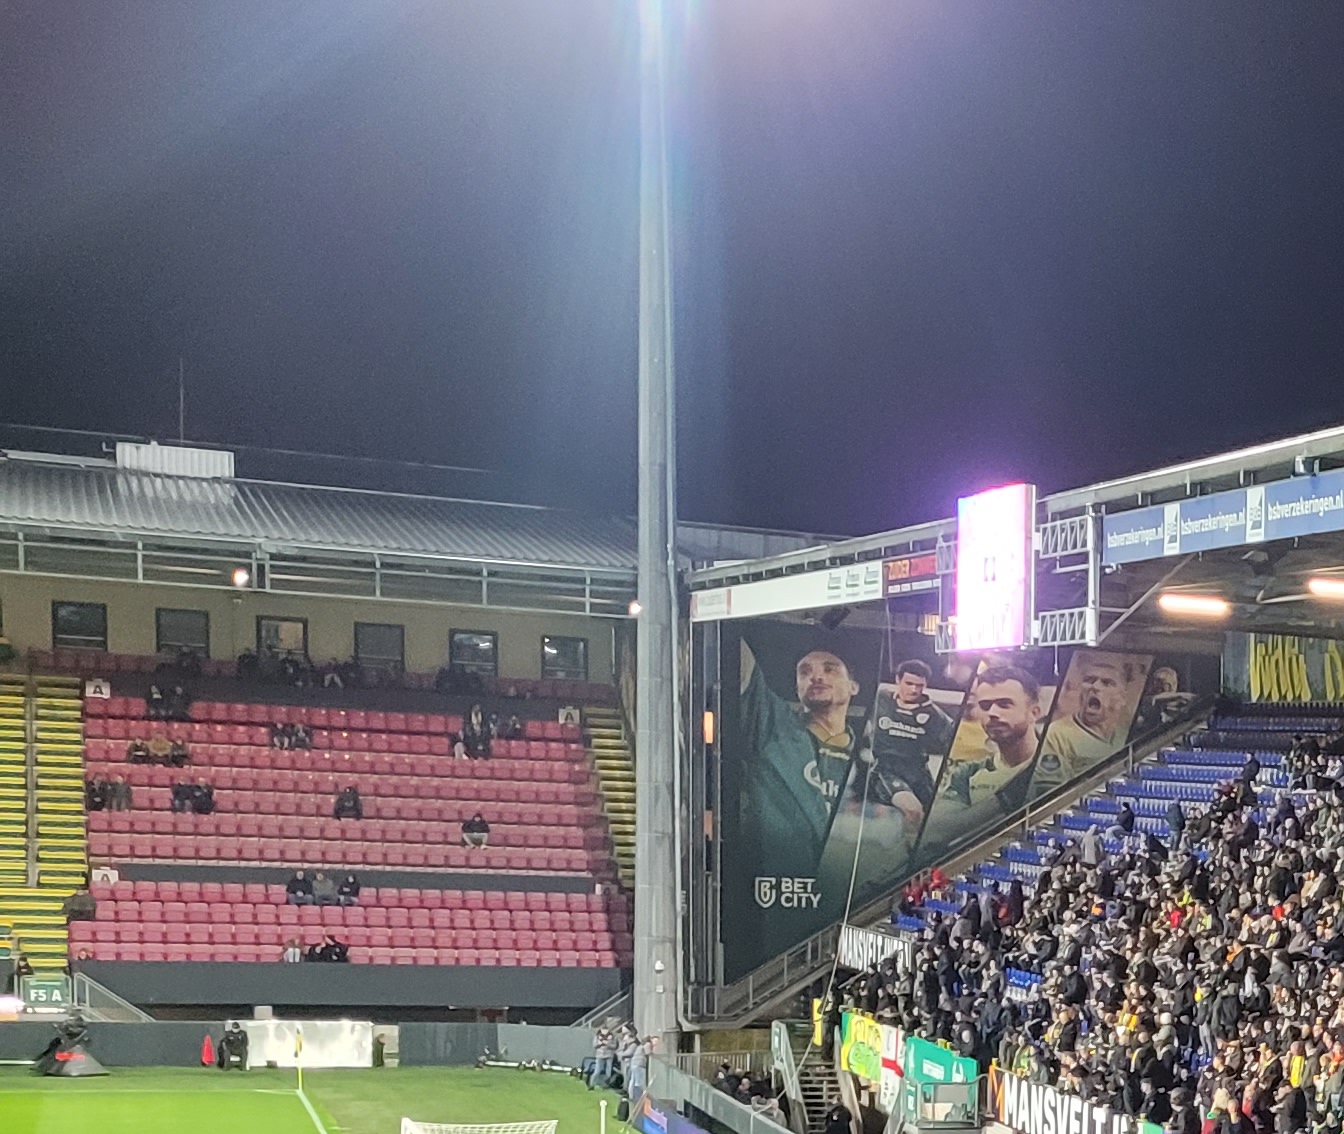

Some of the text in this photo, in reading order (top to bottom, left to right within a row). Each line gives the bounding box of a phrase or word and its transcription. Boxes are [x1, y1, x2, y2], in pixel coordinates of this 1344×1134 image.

[781, 877, 817, 893] BET
[780, 893, 822, 909] CITY
[29, 989, 63, 1002] F5 A
